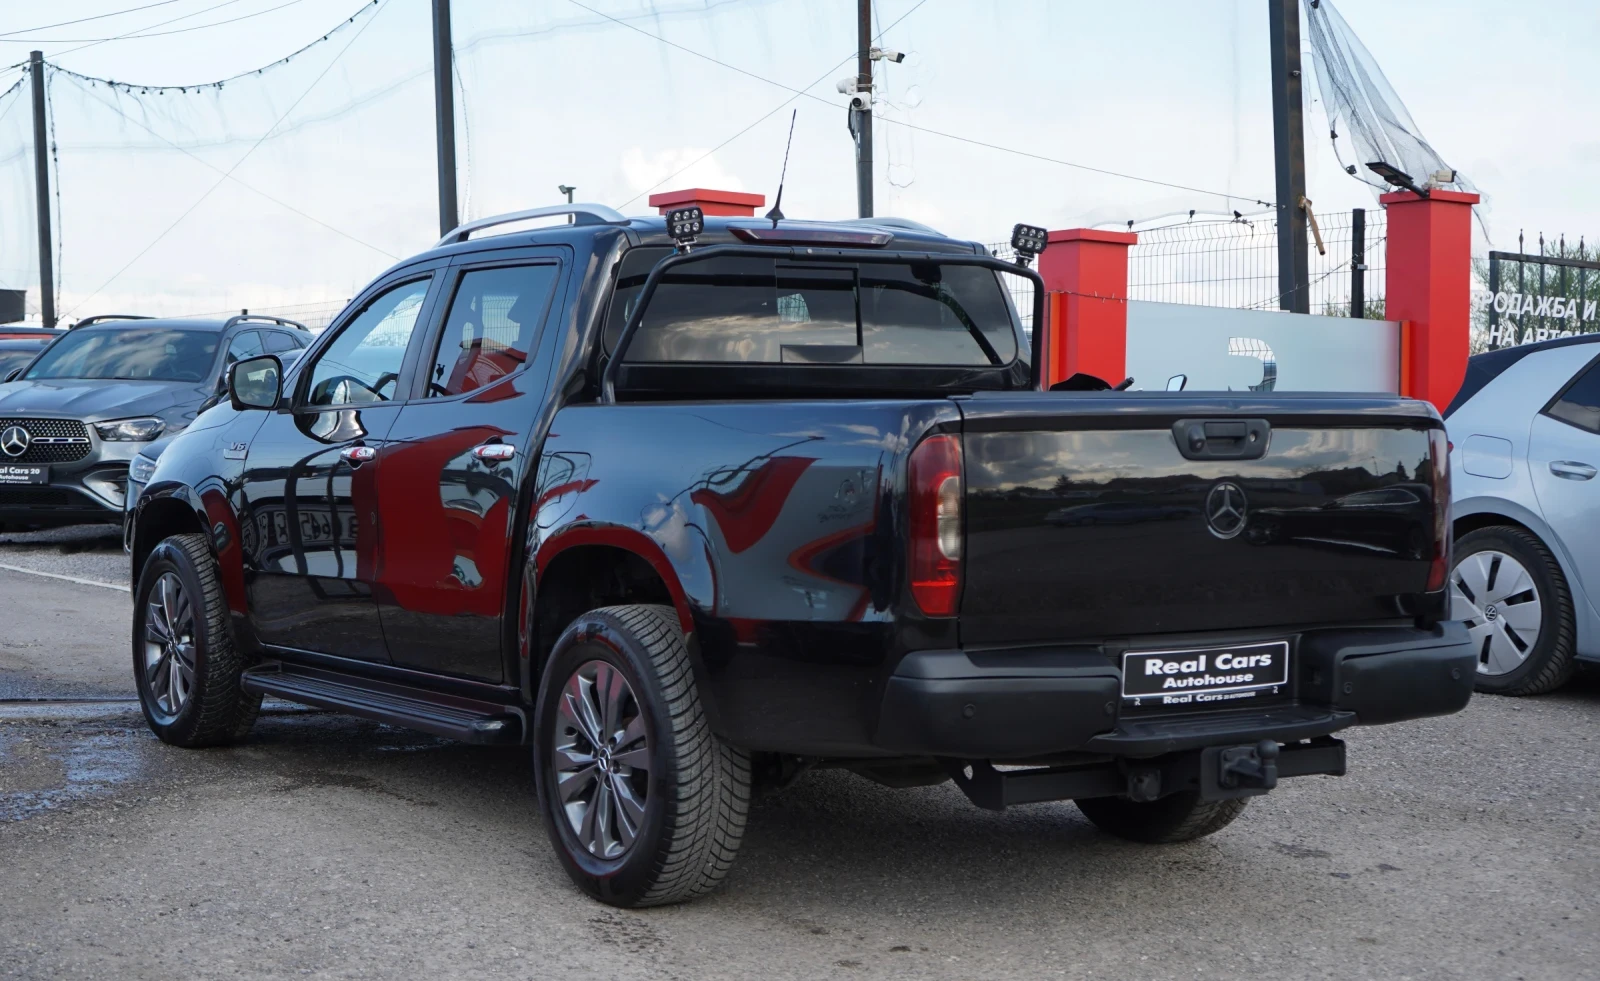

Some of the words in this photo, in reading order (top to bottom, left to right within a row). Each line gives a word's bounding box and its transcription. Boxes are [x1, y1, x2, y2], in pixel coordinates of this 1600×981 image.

[1489, 324, 1515, 346] НА
[230, 441, 247, 450] V6
[1145, 654, 1207, 675] Real
[1215, 653, 1272, 670] Cars
[1163, 672, 1254, 688] Autohouse
[1163, 694, 1193, 704] Real
[1196, 693, 1223, 702] Cars
